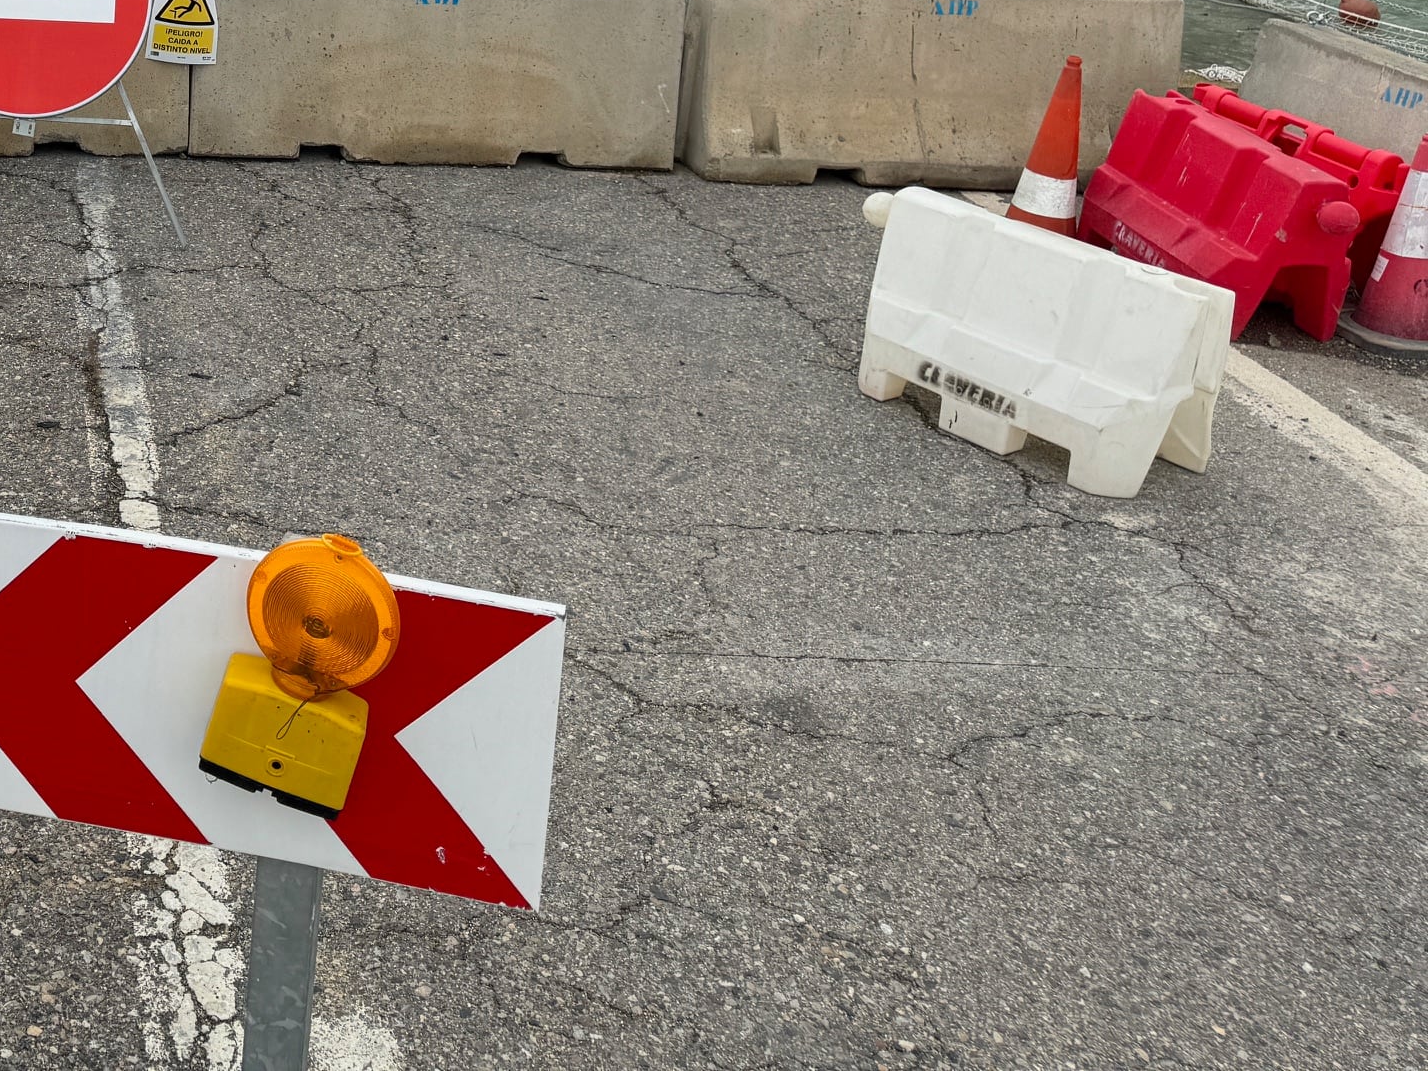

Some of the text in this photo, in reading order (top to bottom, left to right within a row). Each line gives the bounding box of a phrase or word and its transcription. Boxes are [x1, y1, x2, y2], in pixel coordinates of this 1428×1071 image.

[168, 37, 191, 46] CAIDA
[153, 43, 188, 54] DISTINTO
[189, 47, 211, 55] NIVEL
[1381, 86, 1424, 110] AHP
